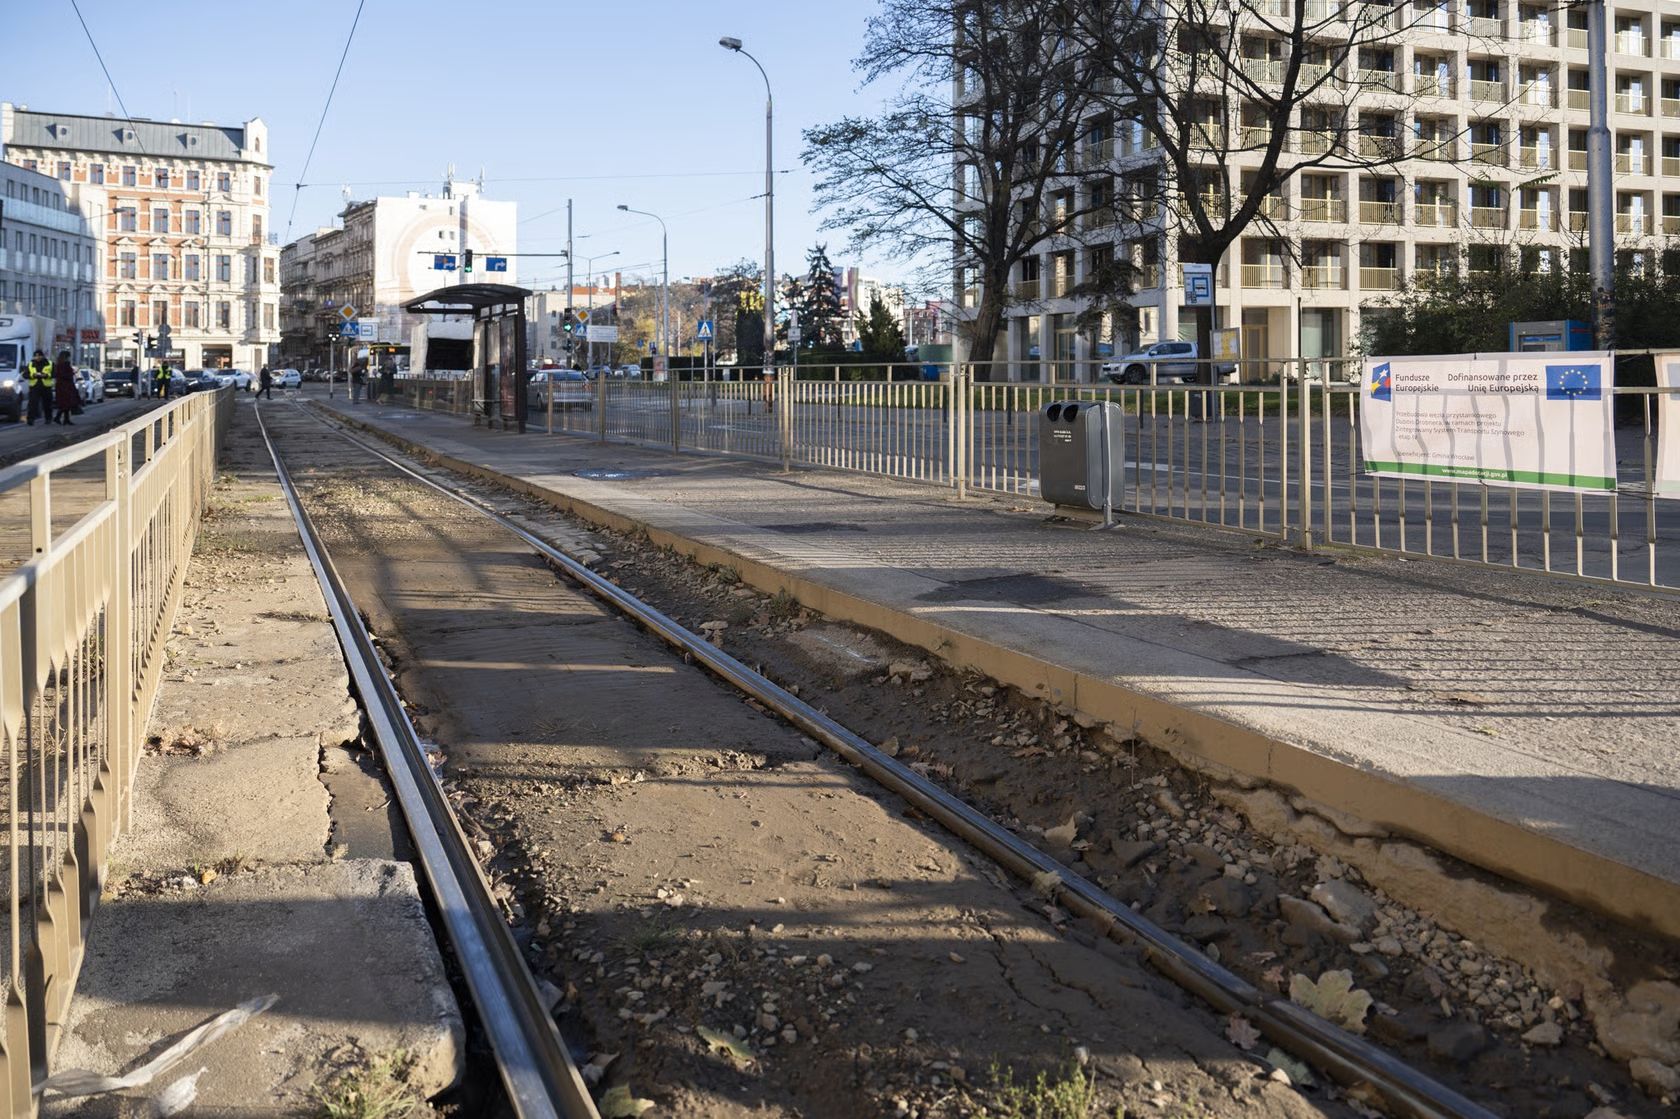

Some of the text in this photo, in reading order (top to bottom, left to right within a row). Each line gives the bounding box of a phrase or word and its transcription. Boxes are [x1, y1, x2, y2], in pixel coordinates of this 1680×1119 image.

[1395, 373, 1430, 382] Fundusze
[1447, 372, 1538, 382] Dofinansowane przez
[1395, 383, 1439, 393] Europejskie
[1467, 383, 1539, 393] Unię Europejską
